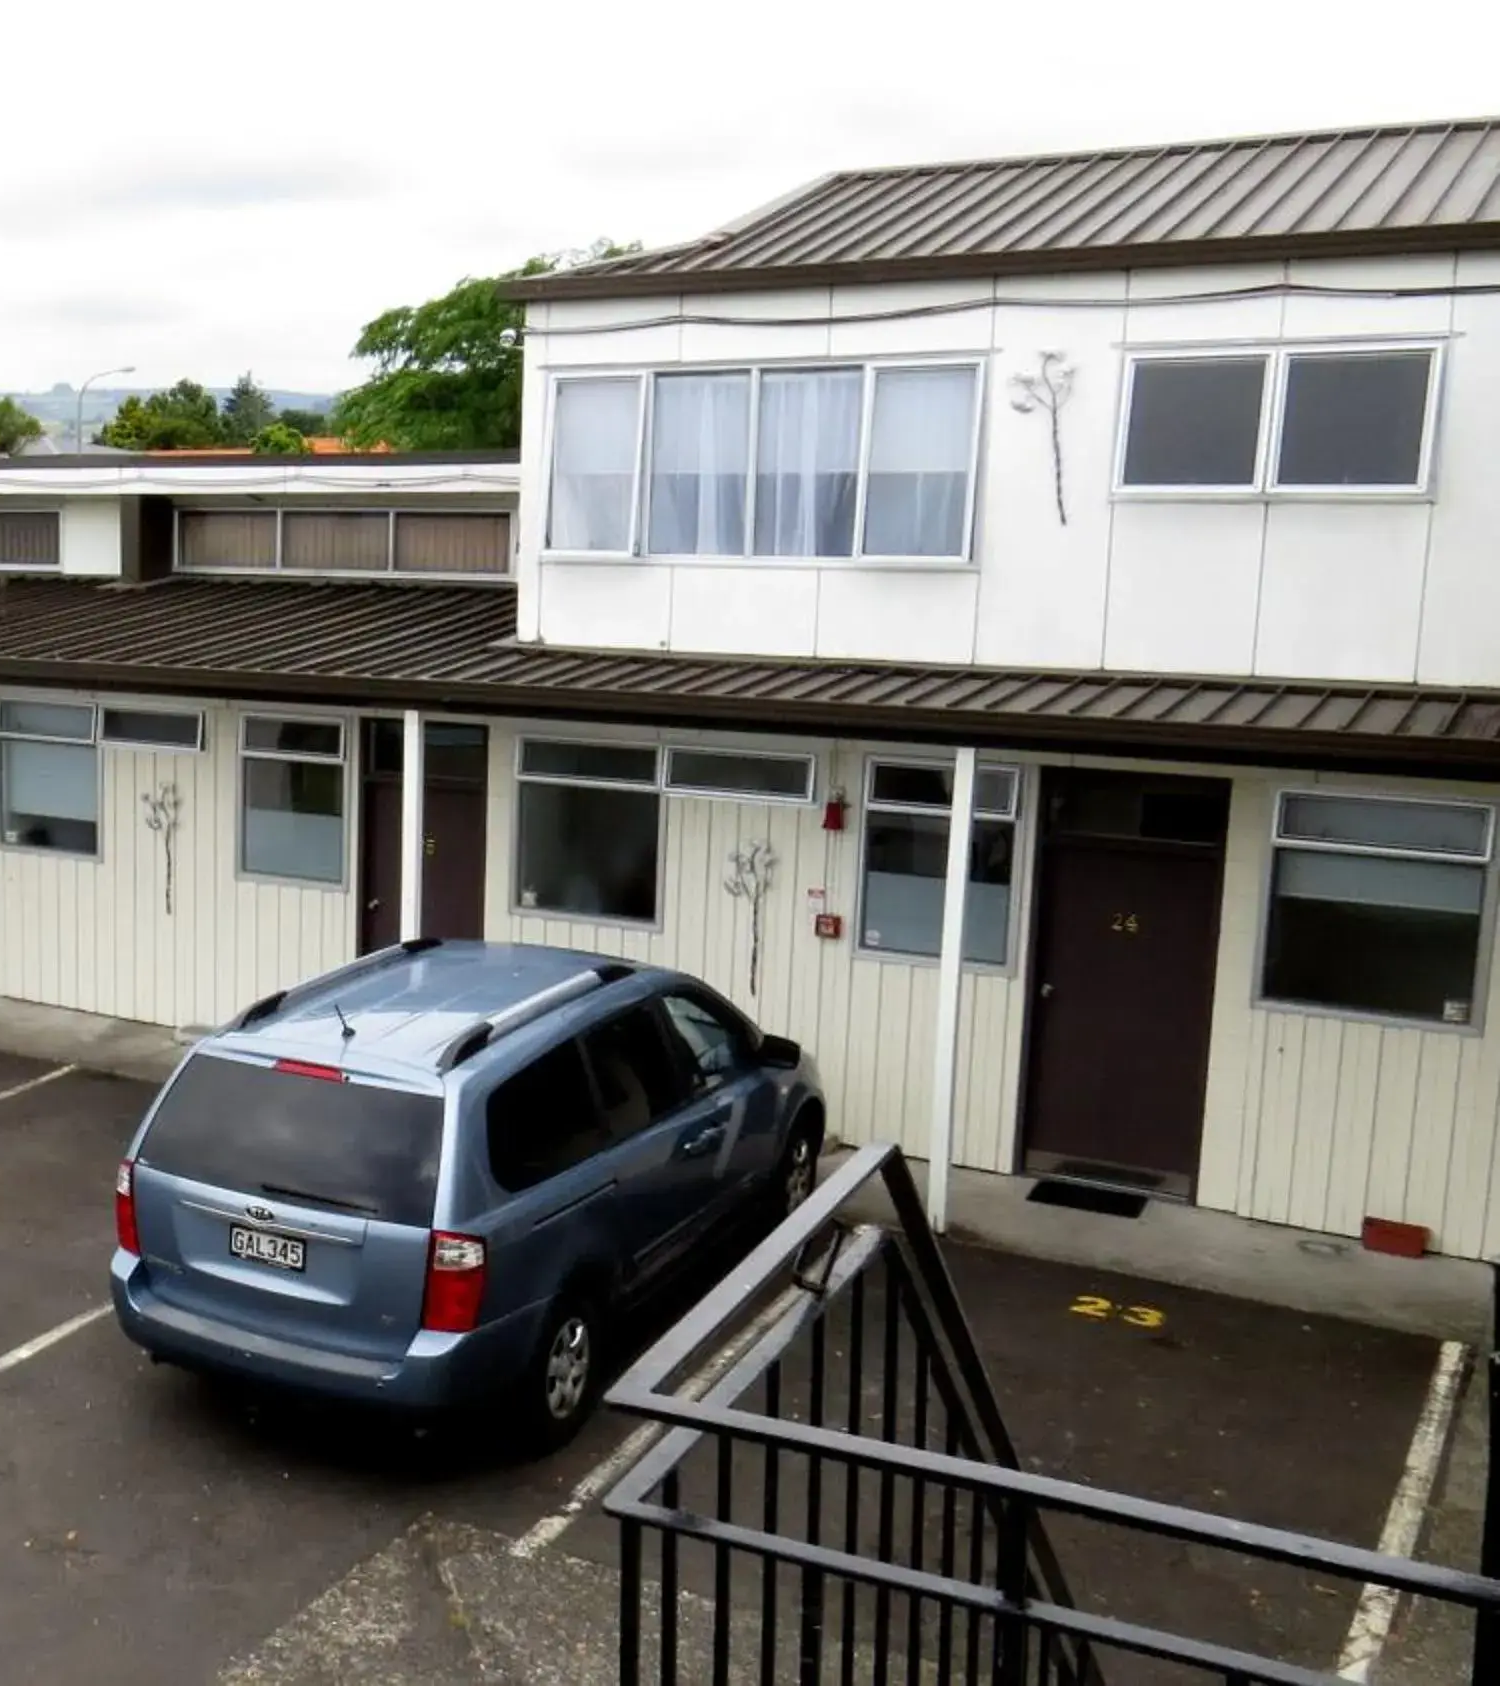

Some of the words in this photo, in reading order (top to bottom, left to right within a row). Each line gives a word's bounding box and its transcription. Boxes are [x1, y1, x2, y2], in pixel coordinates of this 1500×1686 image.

[1111, 912, 1138, 933] 24
[233, 1231, 301, 1265] GAL345
[1068, 1295, 1166, 1327] 23
